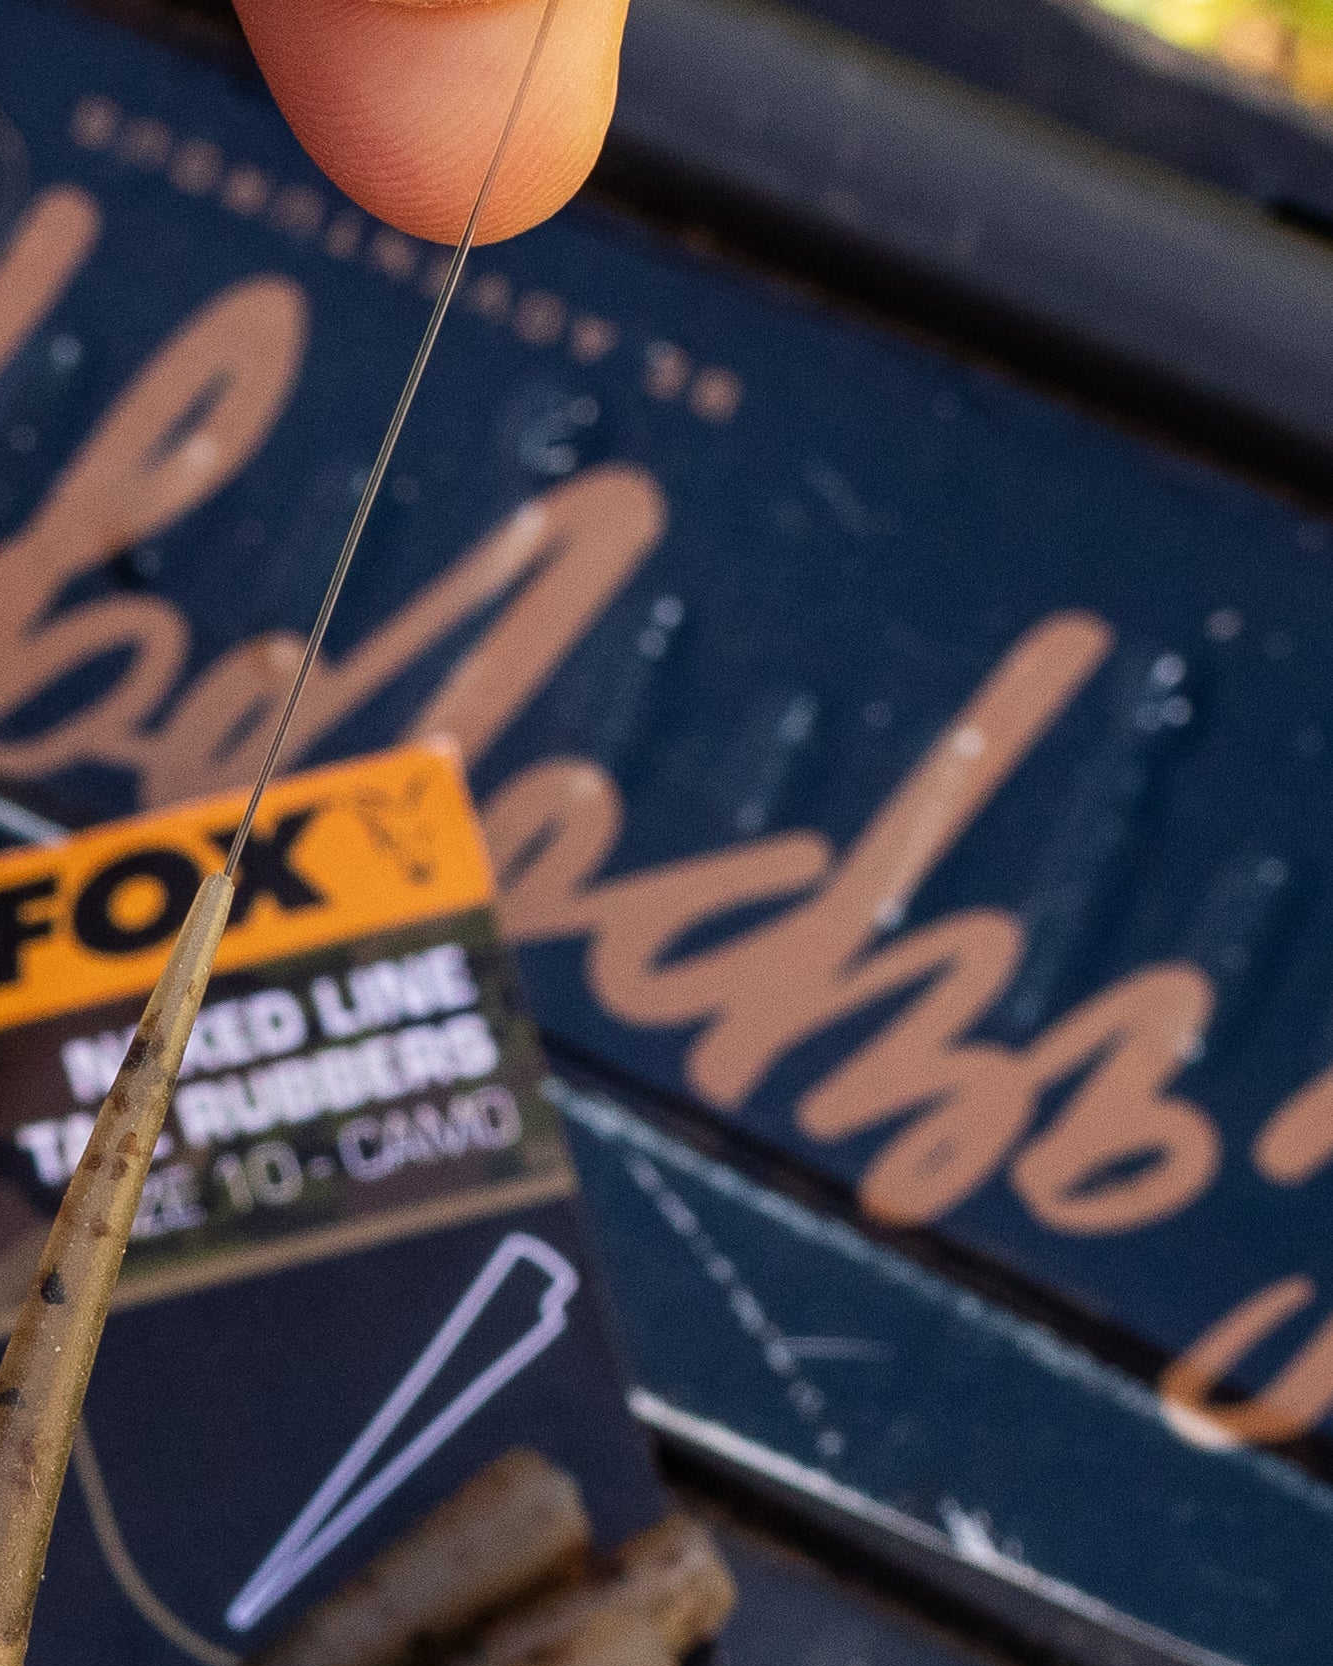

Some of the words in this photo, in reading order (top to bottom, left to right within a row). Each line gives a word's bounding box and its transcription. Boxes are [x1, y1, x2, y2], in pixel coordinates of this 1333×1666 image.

[310, 944, 478, 1038] LINE
[173, 1012, 500, 1148] RUBBERS
[211, 1139, 304, 1214] 10
[338, 1085, 523, 1183] CAMO
